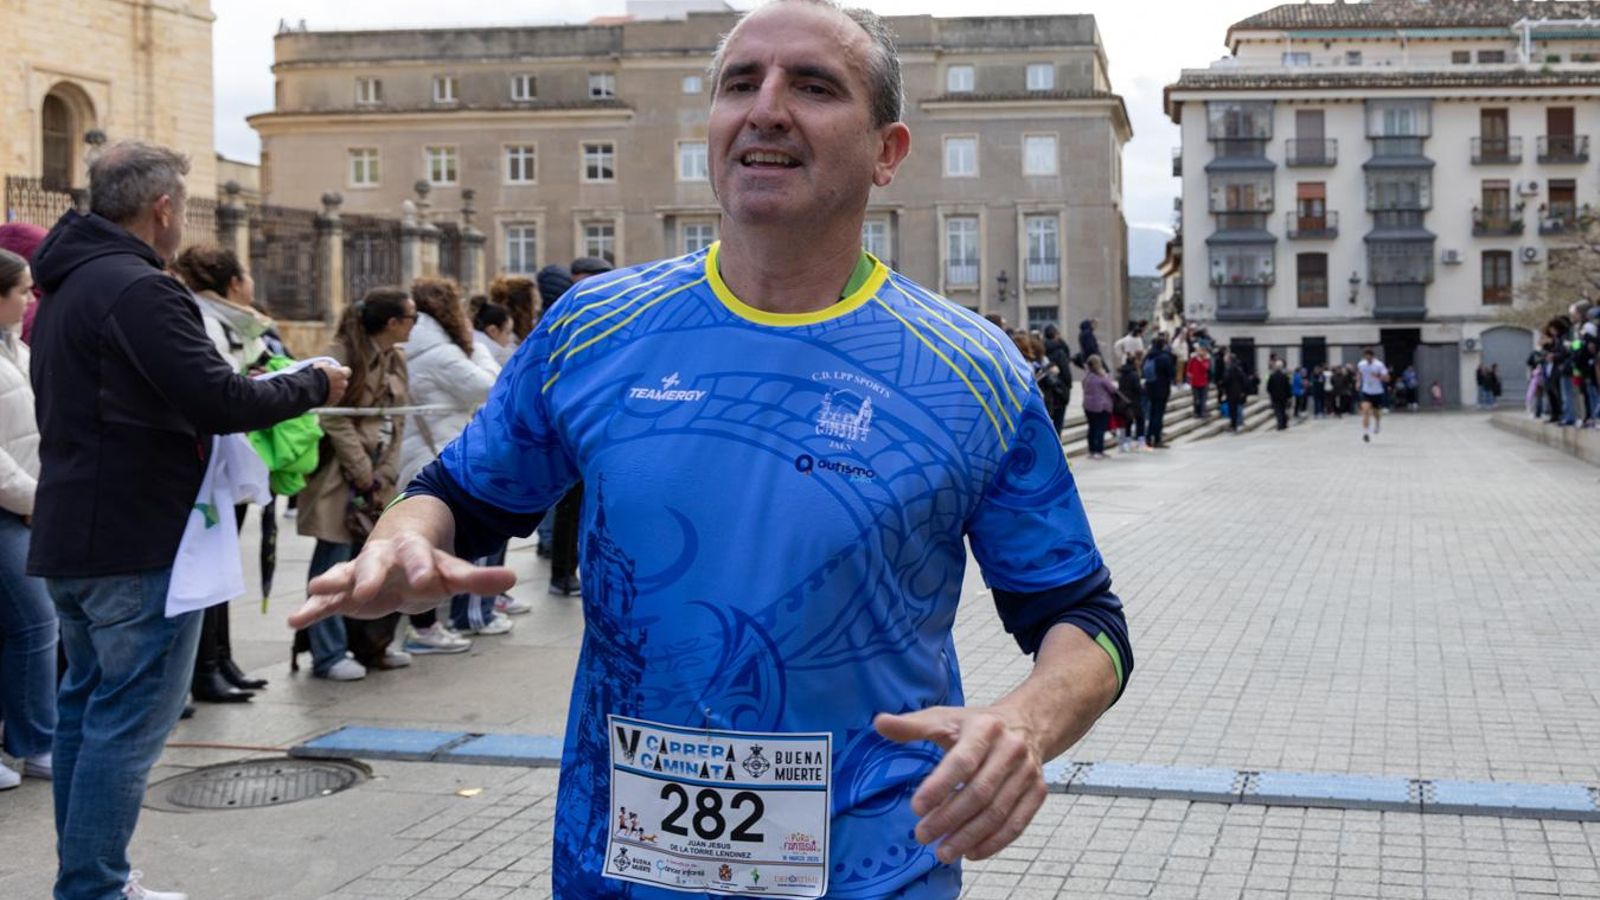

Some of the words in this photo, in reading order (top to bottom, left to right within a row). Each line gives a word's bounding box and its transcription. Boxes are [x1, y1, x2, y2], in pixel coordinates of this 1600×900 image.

[629, 387, 707, 401] TEAMERGY
[646, 735, 736, 762] CARRERA
[775, 751, 823, 765] BUENA
[640, 753, 736, 781] CAMINATA
[775, 767, 822, 781] MUERTE
[660, 783, 765, 843] 282
[680, 845, 689, 853] LA
[690, 847, 714, 857] TORRE
[715, 850, 752, 859] LENDINEZ
[687, 840, 707, 849] JUAN
[708, 842, 731, 850] JESUS
